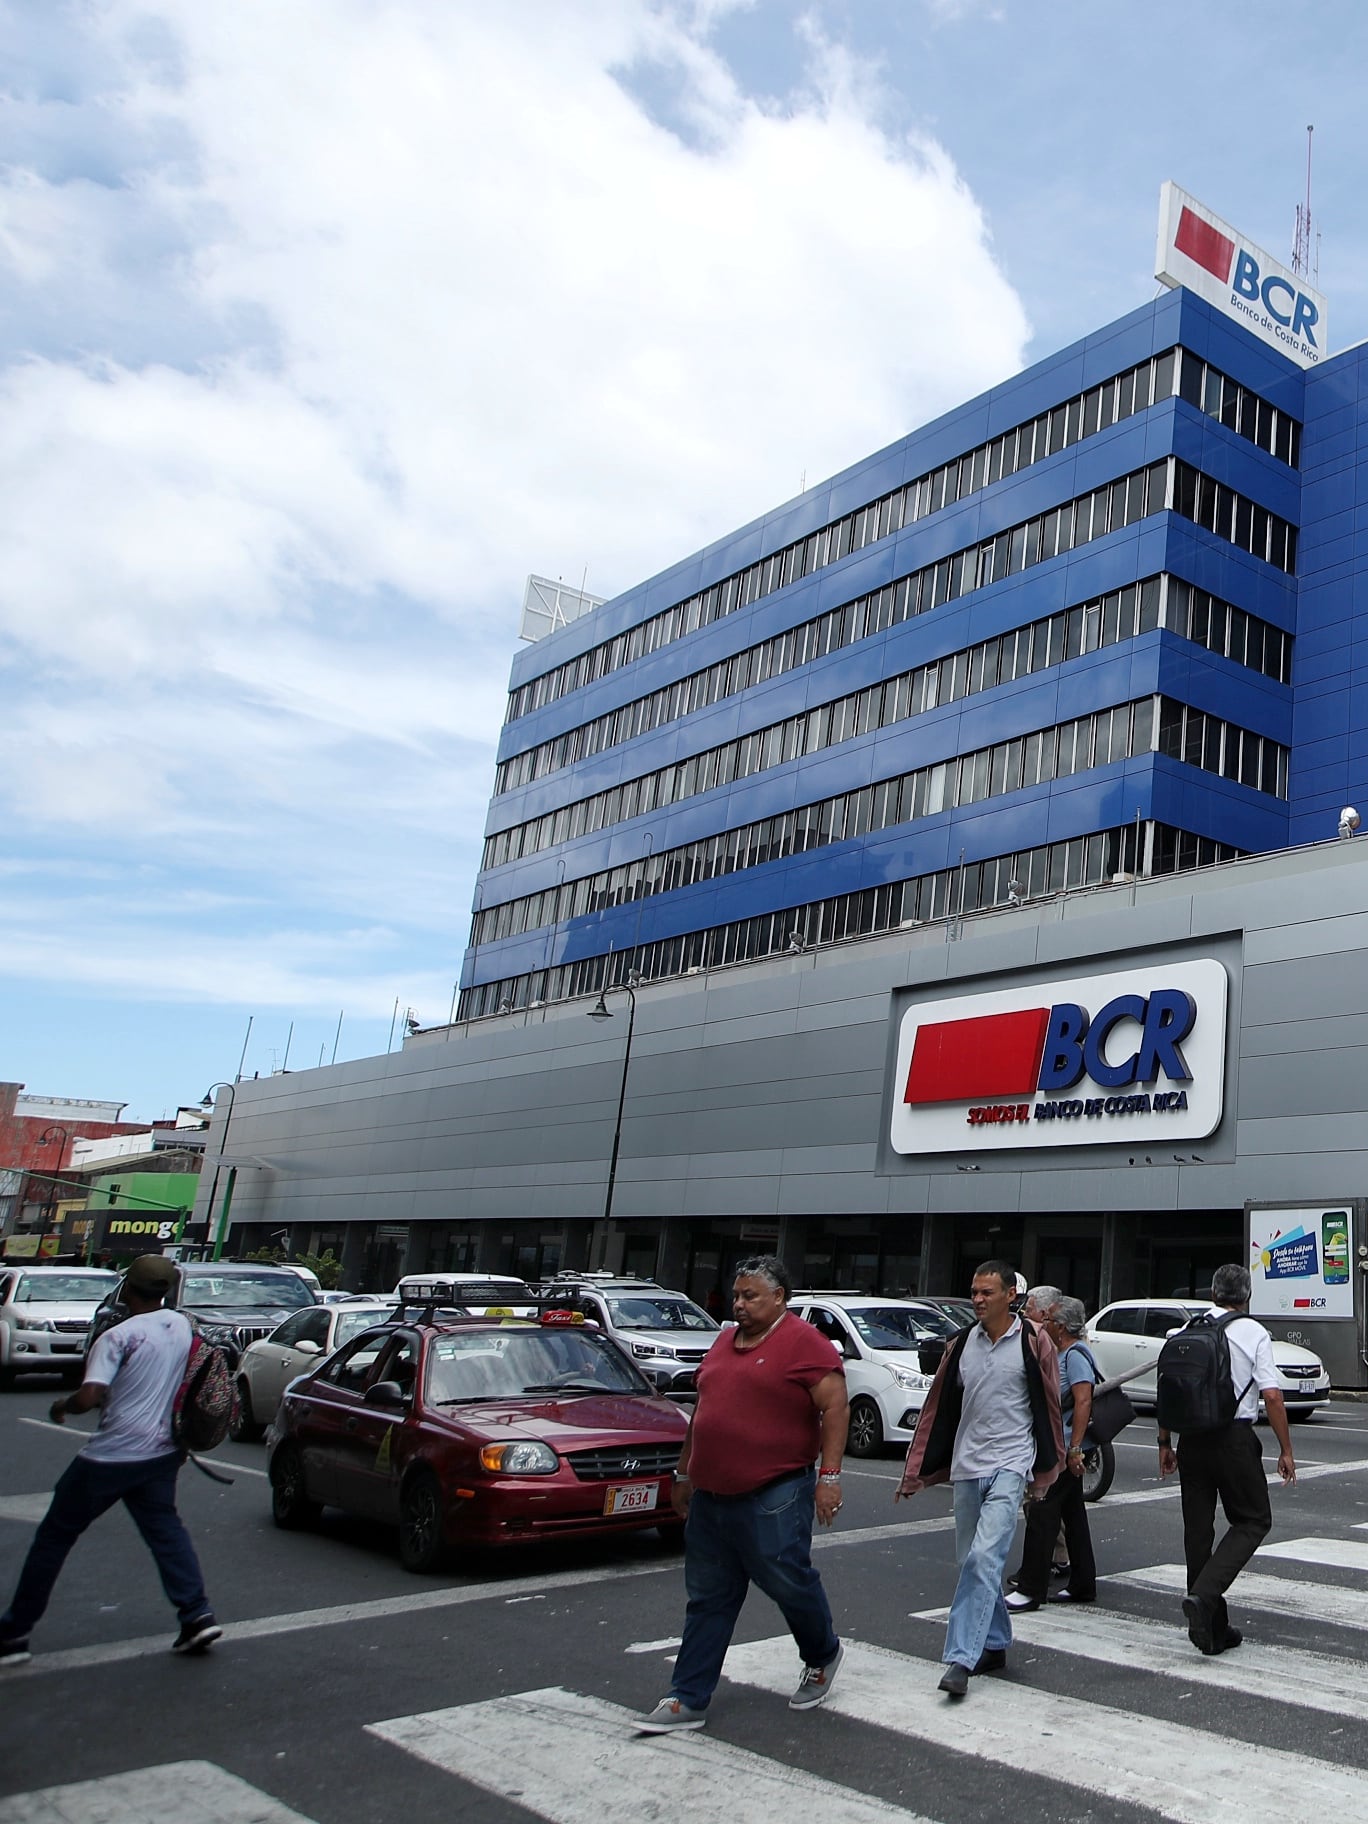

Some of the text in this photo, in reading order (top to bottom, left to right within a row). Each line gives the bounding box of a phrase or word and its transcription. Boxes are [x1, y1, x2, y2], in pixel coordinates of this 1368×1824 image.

[1232, 248, 1319, 349] BCR
[1230, 293, 1319, 362] Banco de Costa Rica
[1037, 988, 1198, 1091] BCR
[966, 1091, 1188, 1125] SOMOS EL BANCO DE COSTA RICA
[549, 1313, 572, 1321] Taxi
[1310, 1298, 1327, 1308] BCR
[621, 1491, 649, 1507] 2634
